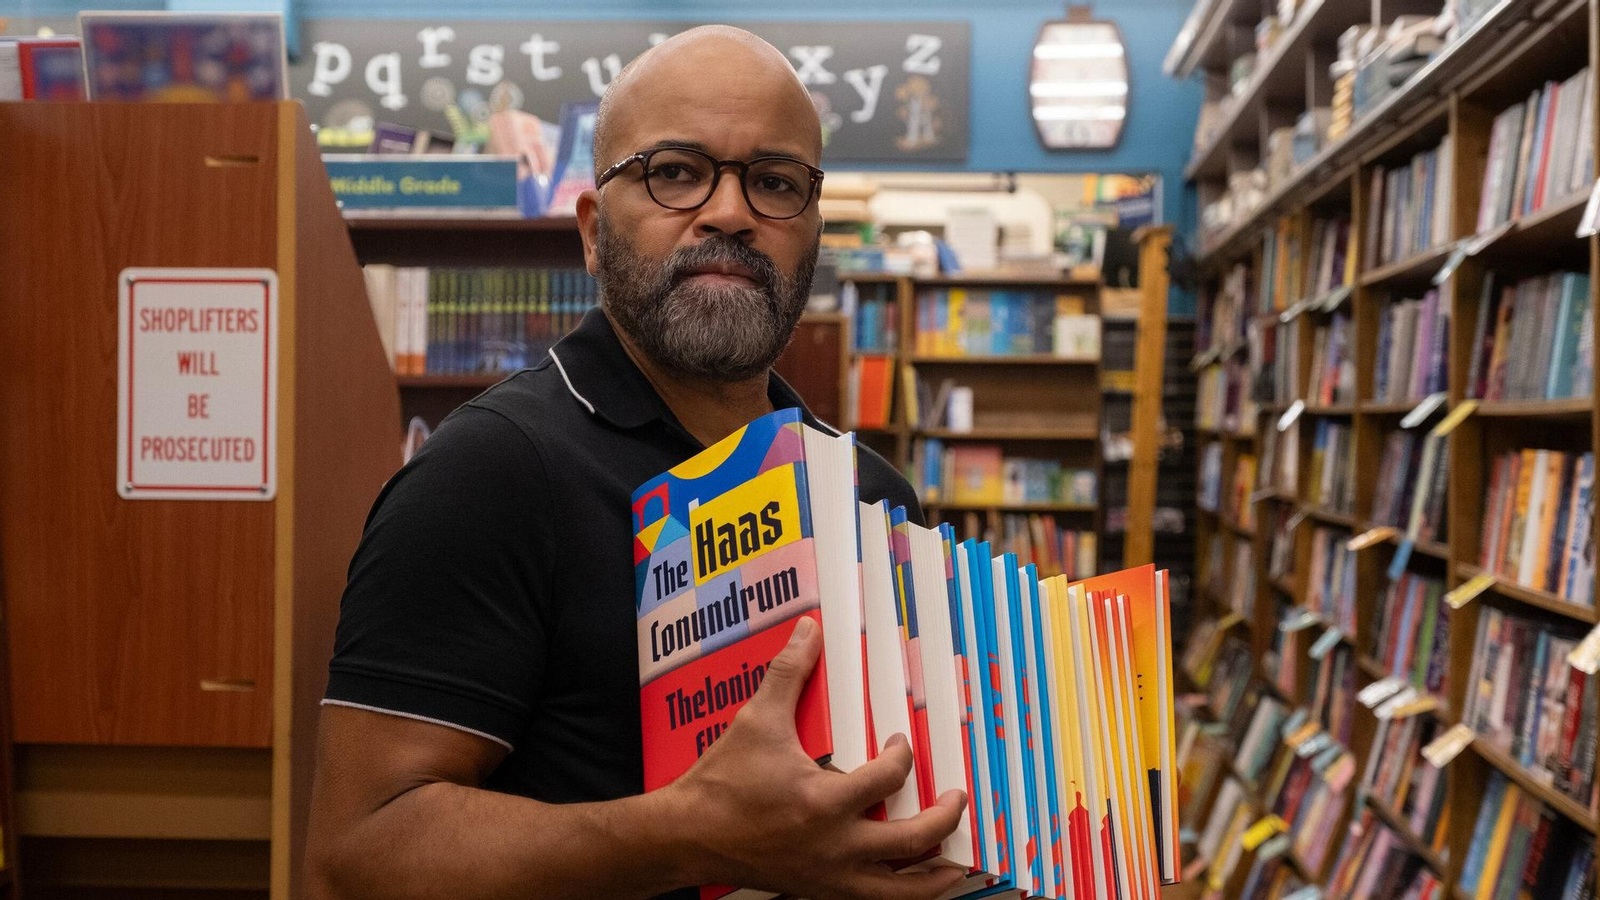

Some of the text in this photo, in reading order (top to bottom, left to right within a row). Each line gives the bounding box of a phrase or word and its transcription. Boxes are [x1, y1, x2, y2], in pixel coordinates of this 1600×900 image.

[331, 175, 462, 195] Middle Grade
[139, 308, 259, 333] SHOPLIFTERS
[176, 352, 220, 376] WILL
[187, 394, 210, 419] BE
[140, 436, 256, 462] PROSECUTED
[653, 501, 783, 601] The Haas
[651, 566, 800, 662] Conundrum
[665, 661, 771, 731] Thelonio
